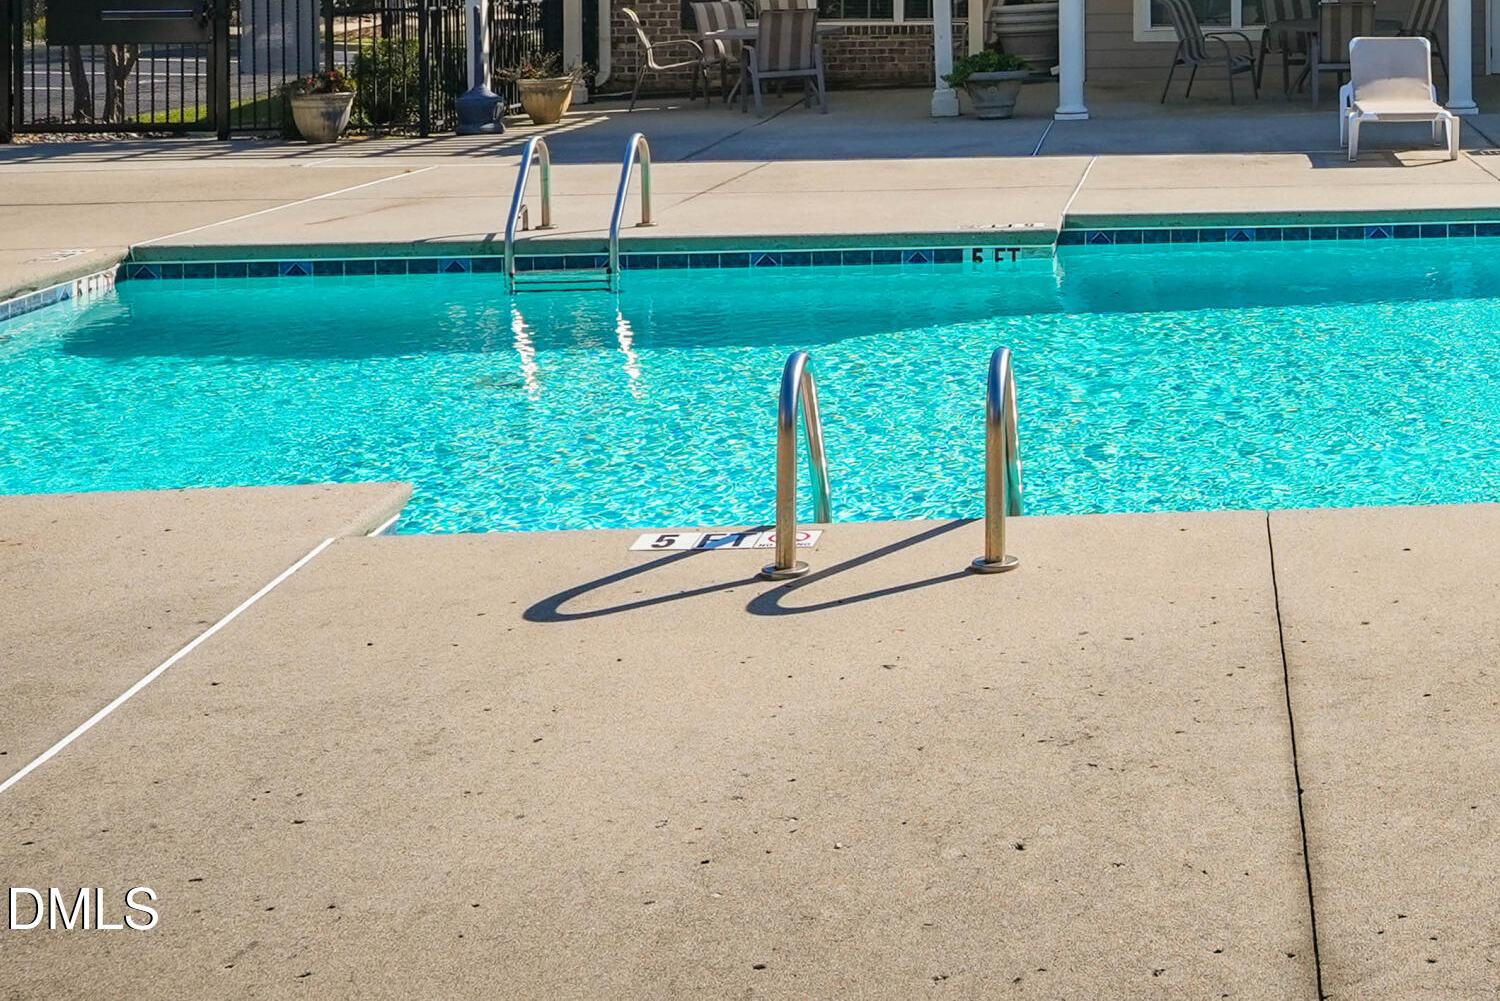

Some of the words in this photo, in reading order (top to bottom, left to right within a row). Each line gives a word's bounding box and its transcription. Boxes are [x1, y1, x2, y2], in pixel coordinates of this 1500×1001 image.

[993, 247, 1021, 263] FT
[651, 533, 680, 549] 5
[697, 531, 758, 548] FT
